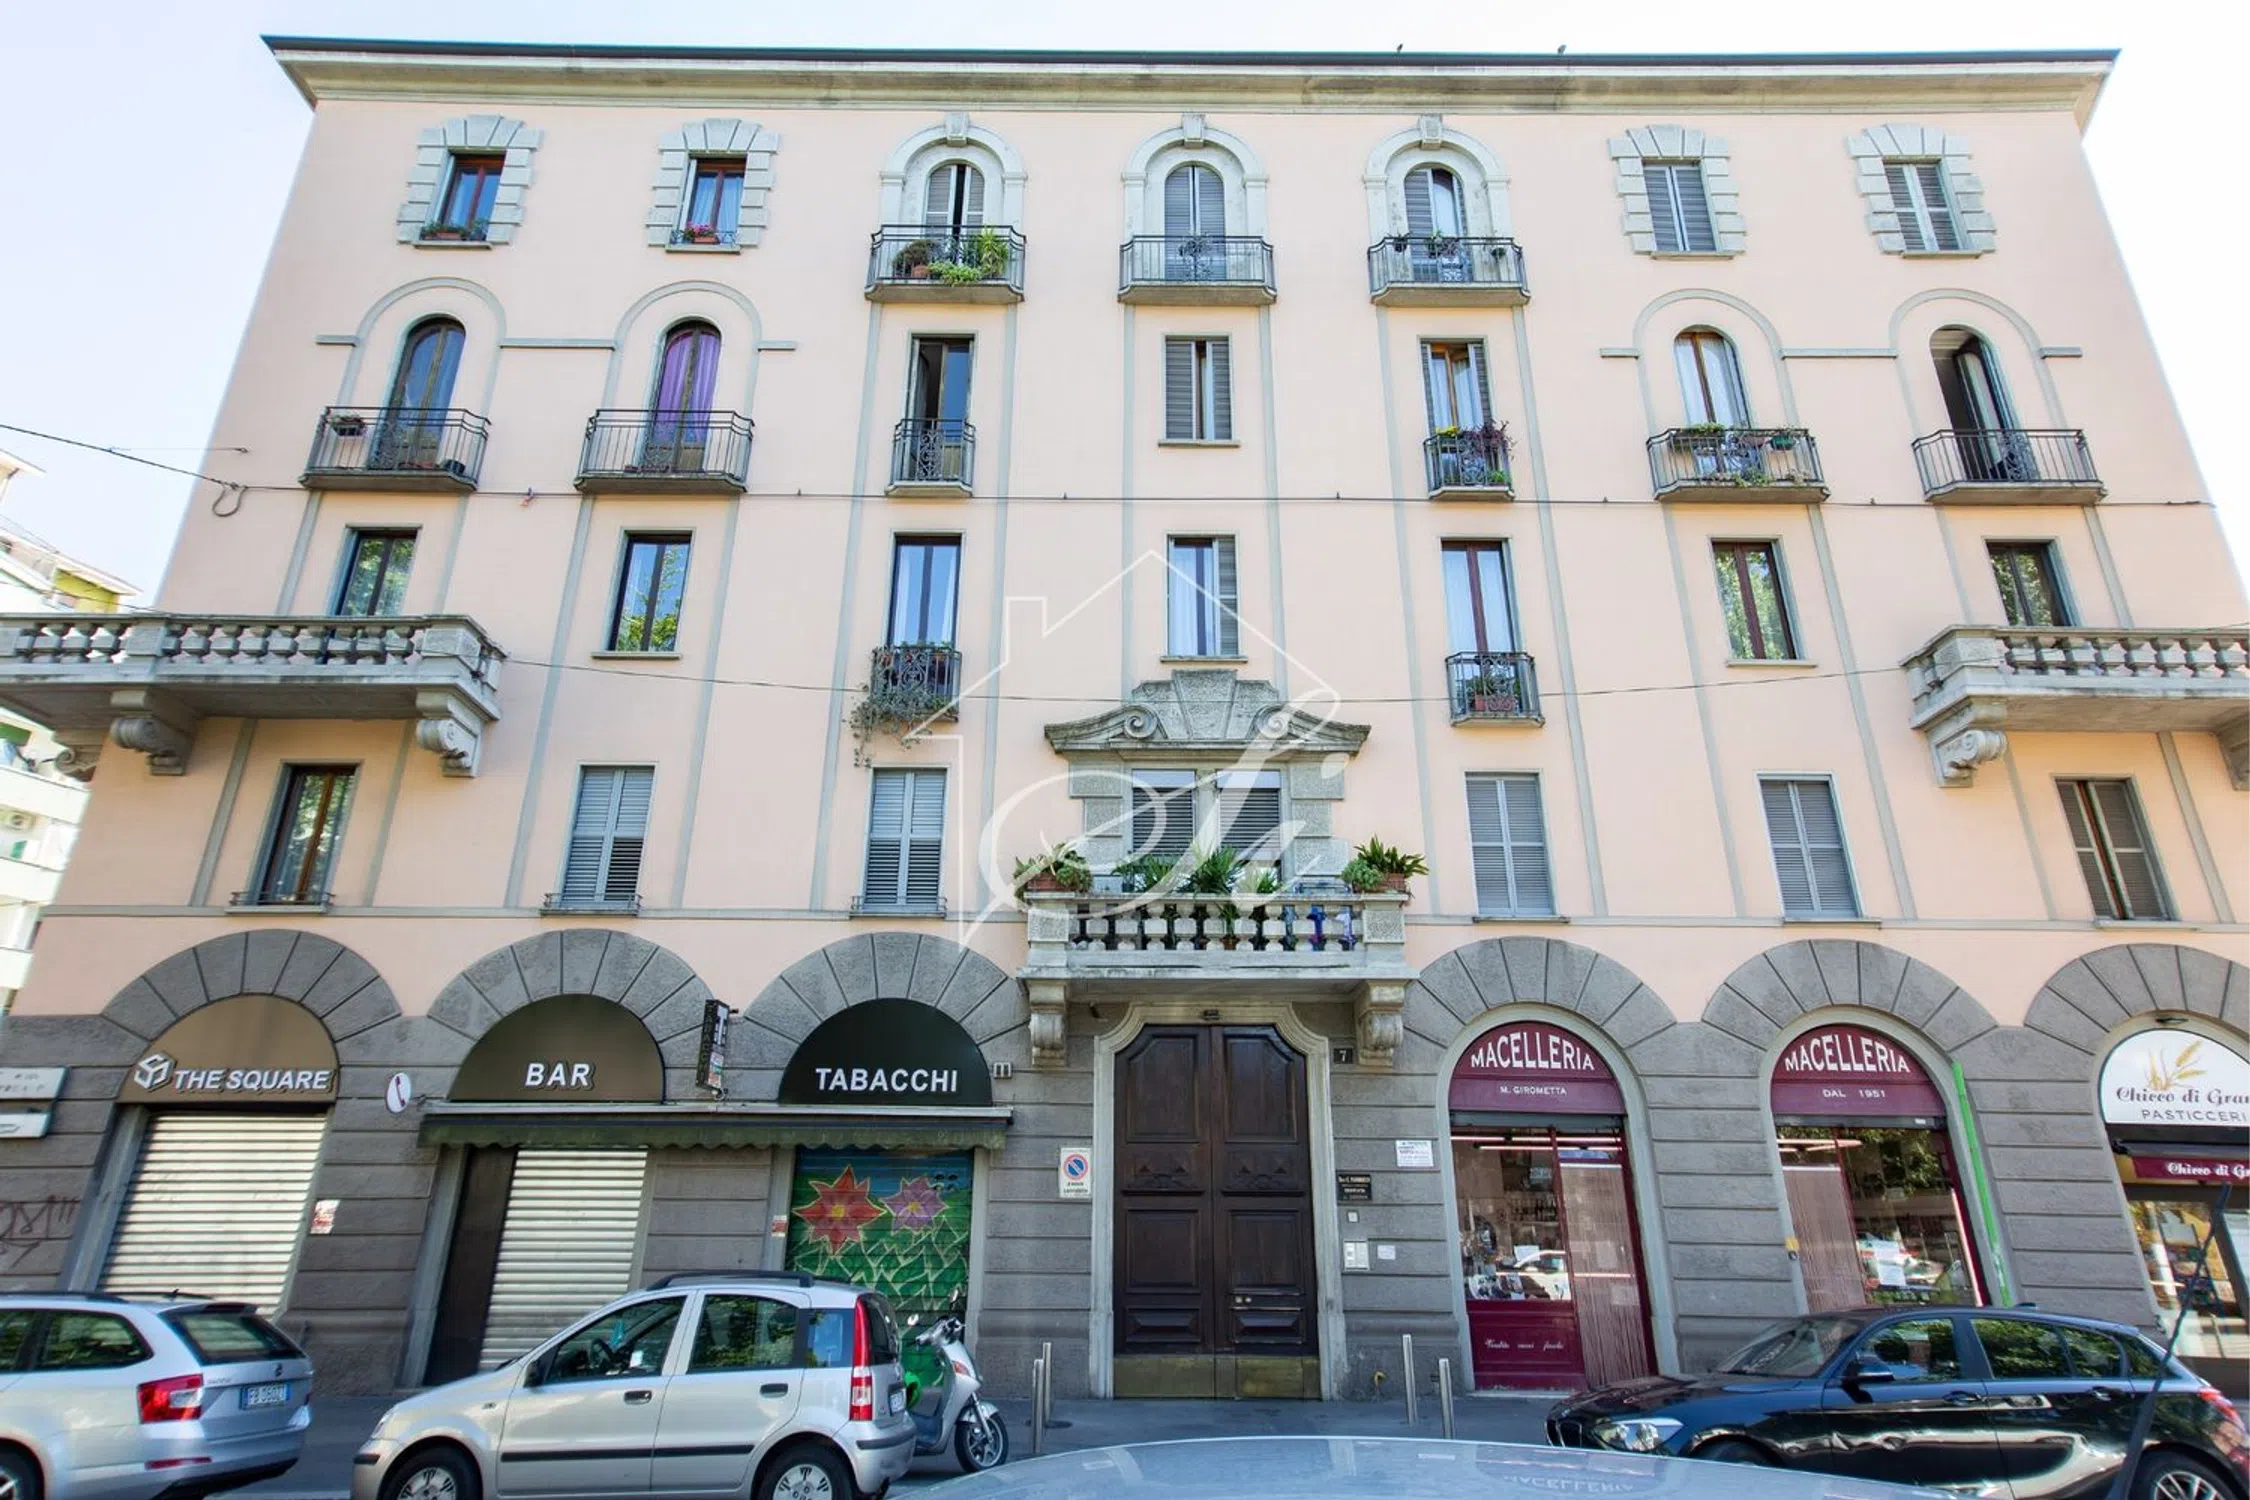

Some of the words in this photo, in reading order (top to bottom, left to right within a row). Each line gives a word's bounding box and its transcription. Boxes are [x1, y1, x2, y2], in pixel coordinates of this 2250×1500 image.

[1339, 1050, 1347, 1062] 7
[1471, 1032, 1595, 1070] MACELLERIA
[1784, 1034, 1911, 1073] MACELLERIA
[174, 1070, 224, 1090] THE
[226, 1070, 331, 1091] SQUARE
[525, 1063, 591, 1087] BAR
[815, 1068, 958, 1092] TABACCHI
[1513, 1086, 1568, 1096] GIROMETTA
[1822, 1089, 1847, 1098] DAL
[1859, 1089, 1887, 1098] 1951
[2116, 1086, 2175, 1102] Chicco
[2182, 1088, 2200, 1103] di
[2141, 1109, 2248, 1122] PASTICCERI
[2167, 1162, 2212, 1176] Chicco
[2215, 1163, 2231, 1177] di
